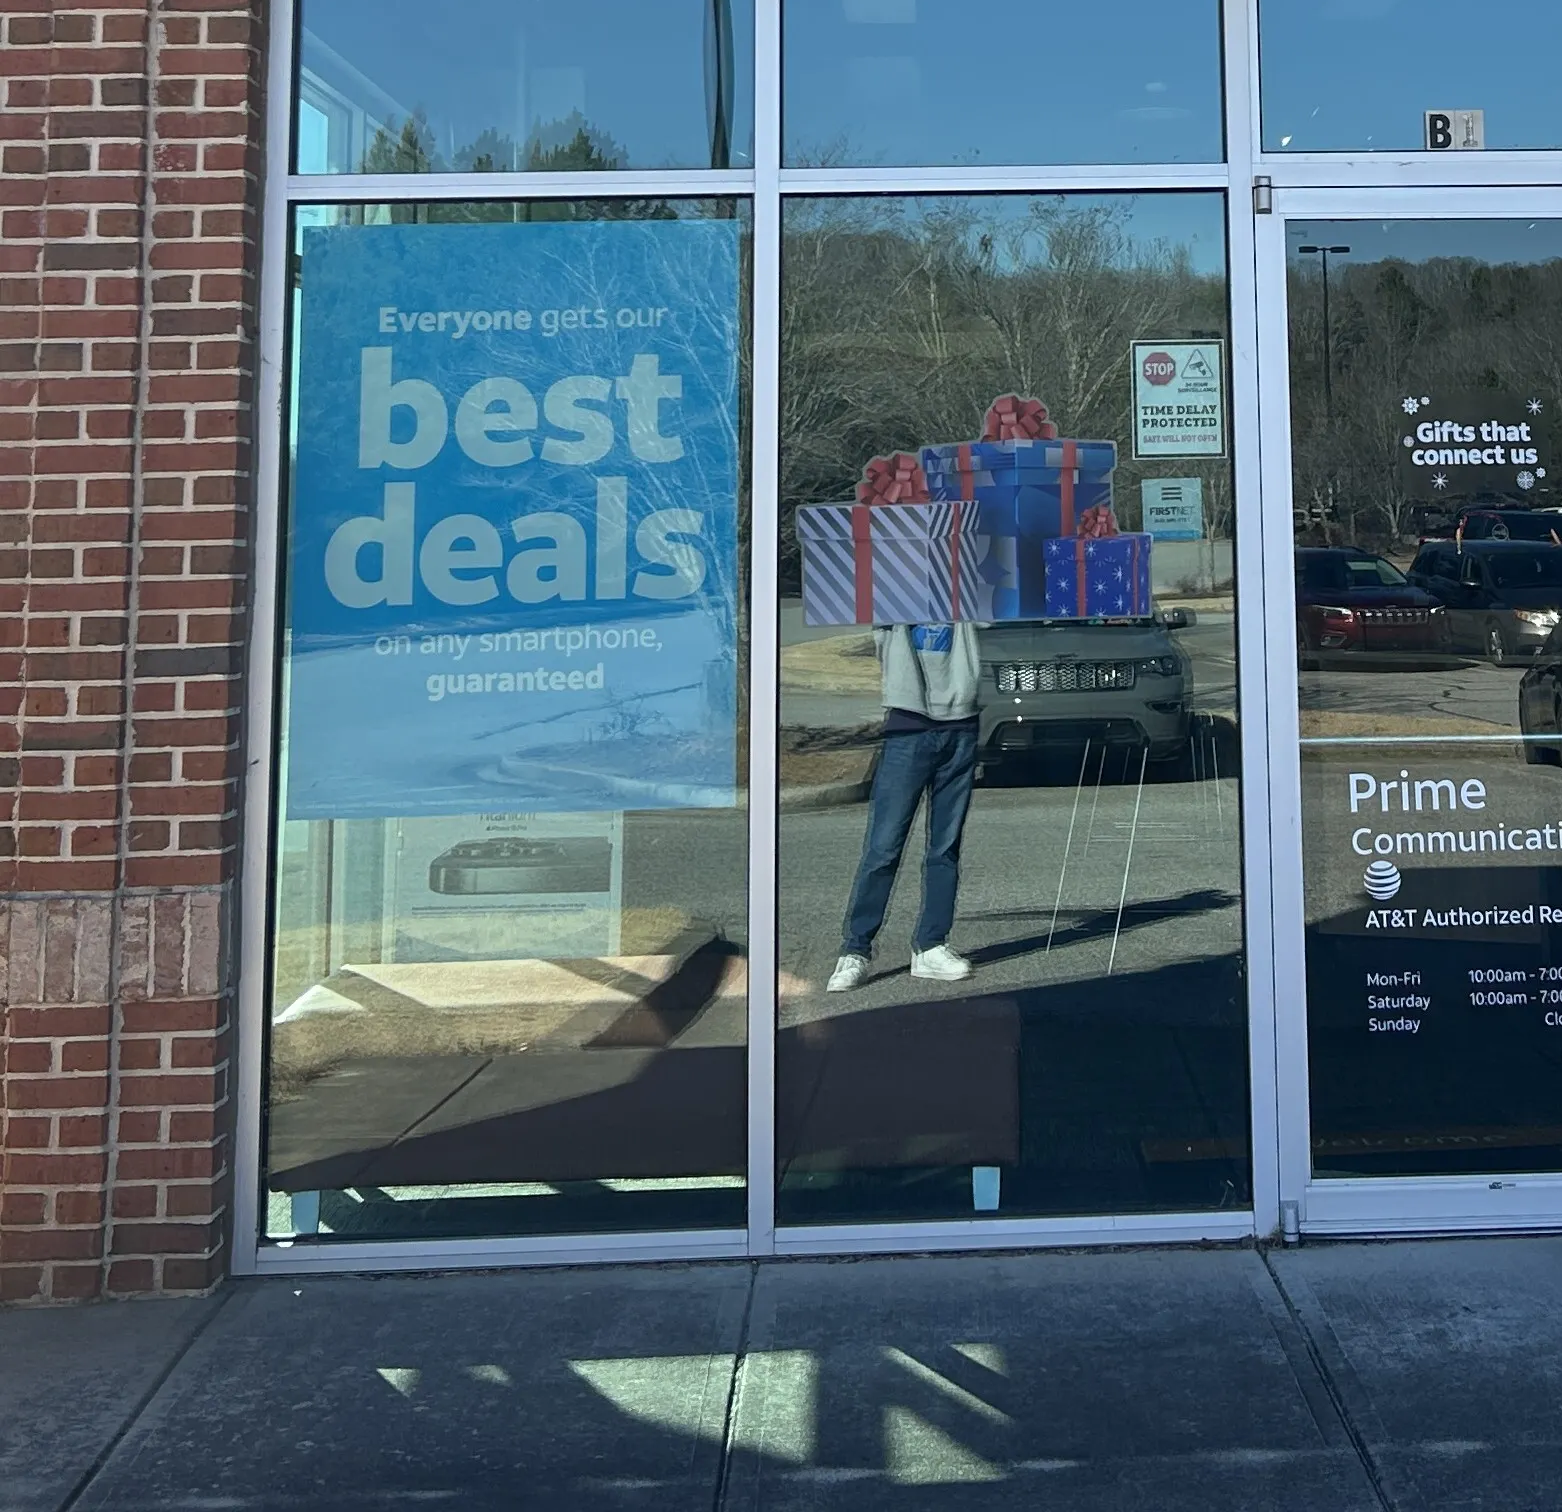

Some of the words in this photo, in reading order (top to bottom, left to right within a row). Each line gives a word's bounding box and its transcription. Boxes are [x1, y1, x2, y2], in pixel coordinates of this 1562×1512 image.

[379, 306, 532, 339] Everyone
[541, 305, 607, 337] gets
[616, 306, 669, 328] our
[1144, 362, 1175, 376] STOP
[358, 347, 685, 470] best
[1142, 405, 1174, 416] TIME
[1176, 404, 1218, 415] DELAY
[1142, 417, 1217, 428] PROTECTED
[1416, 421, 1476, 443] Gifts
[1480, 420, 1532, 442] that
[1412, 445, 1506, 465] connect
[1510, 448, 1538, 465] us
[324, 476, 707, 609] deals
[375, 634, 412, 656] on
[420, 632, 472, 661] any
[479, 625, 663, 658] smartphone,
[426, 664, 604, 702] guaranteed
[1349, 769, 1487, 813] Prime
[1365, 909, 1418, 929] AT&T
[1422, 904, 1534, 927] Authorized
[1366, 971, 1421, 987] Mon-Fri
[1468, 968, 1527, 984] 10:00am
[1368, 994, 1431, 1011] Saturday
[1469, 992, 1528, 1007] 10:00am
[1368, 1017, 1421, 1034] Sunday
